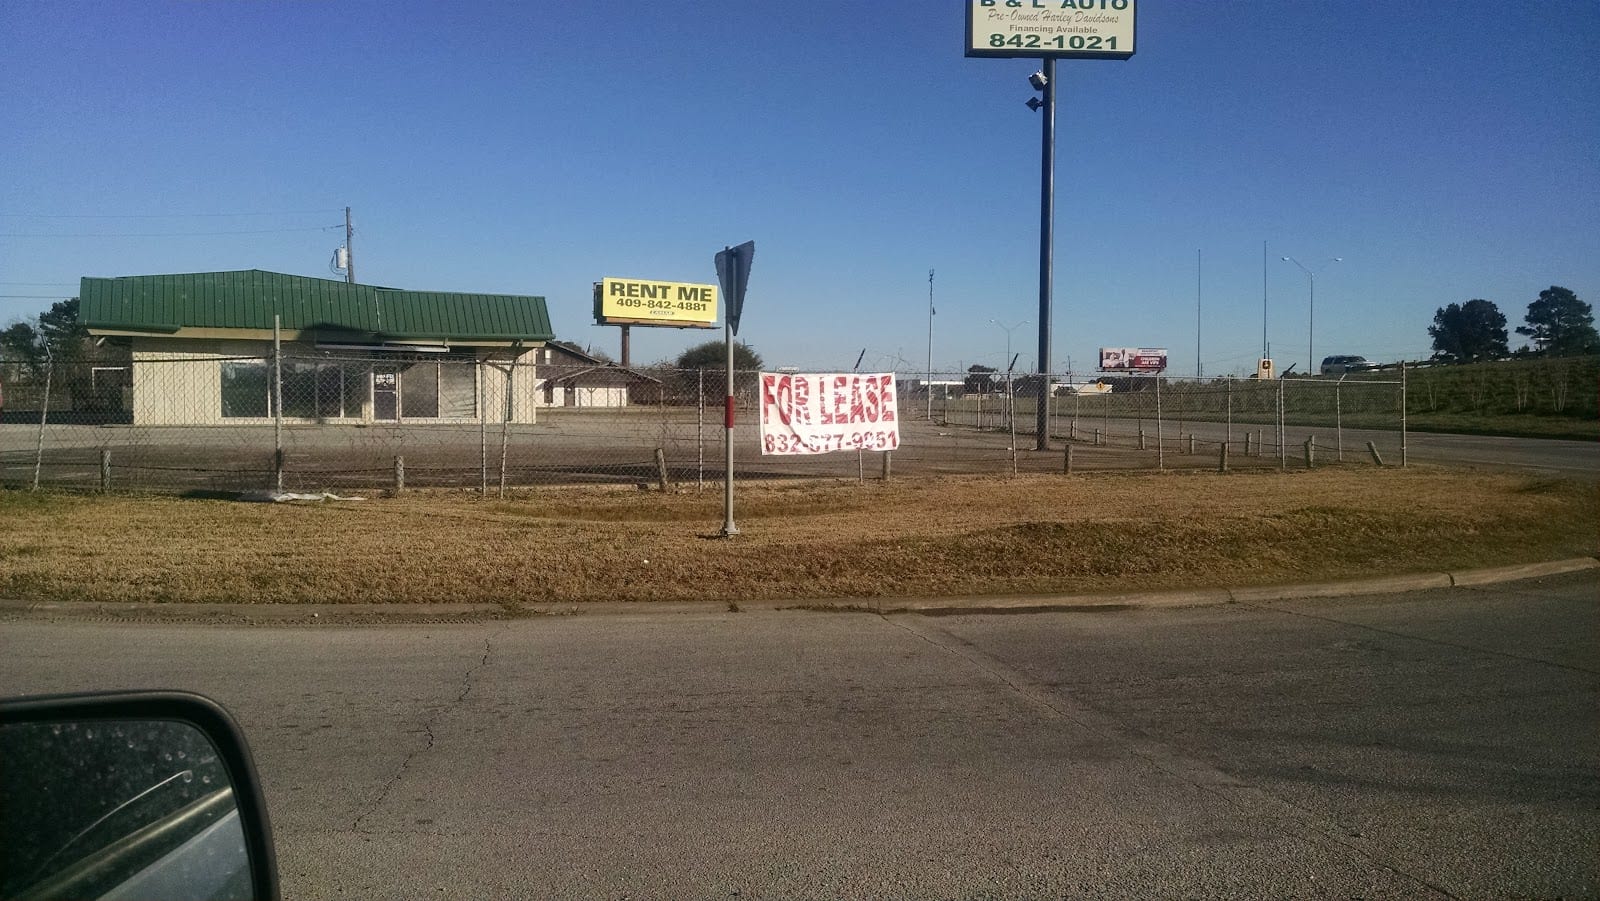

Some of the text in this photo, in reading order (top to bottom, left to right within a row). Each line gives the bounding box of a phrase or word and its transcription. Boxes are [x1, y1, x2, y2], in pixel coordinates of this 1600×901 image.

[1060, 0, 1128, 11] AUTO
[987, 8, 1119, 24] Pre-Owned Harley Davidsons
[1009, 24, 1098, 34] Financing Available
[989, 33, 1117, 50] 842-1021
[610, 281, 712, 302] RENT ME
[616, 298, 707, 311] 409-842-4881
[763, 375, 895, 426] FOR LEASE
